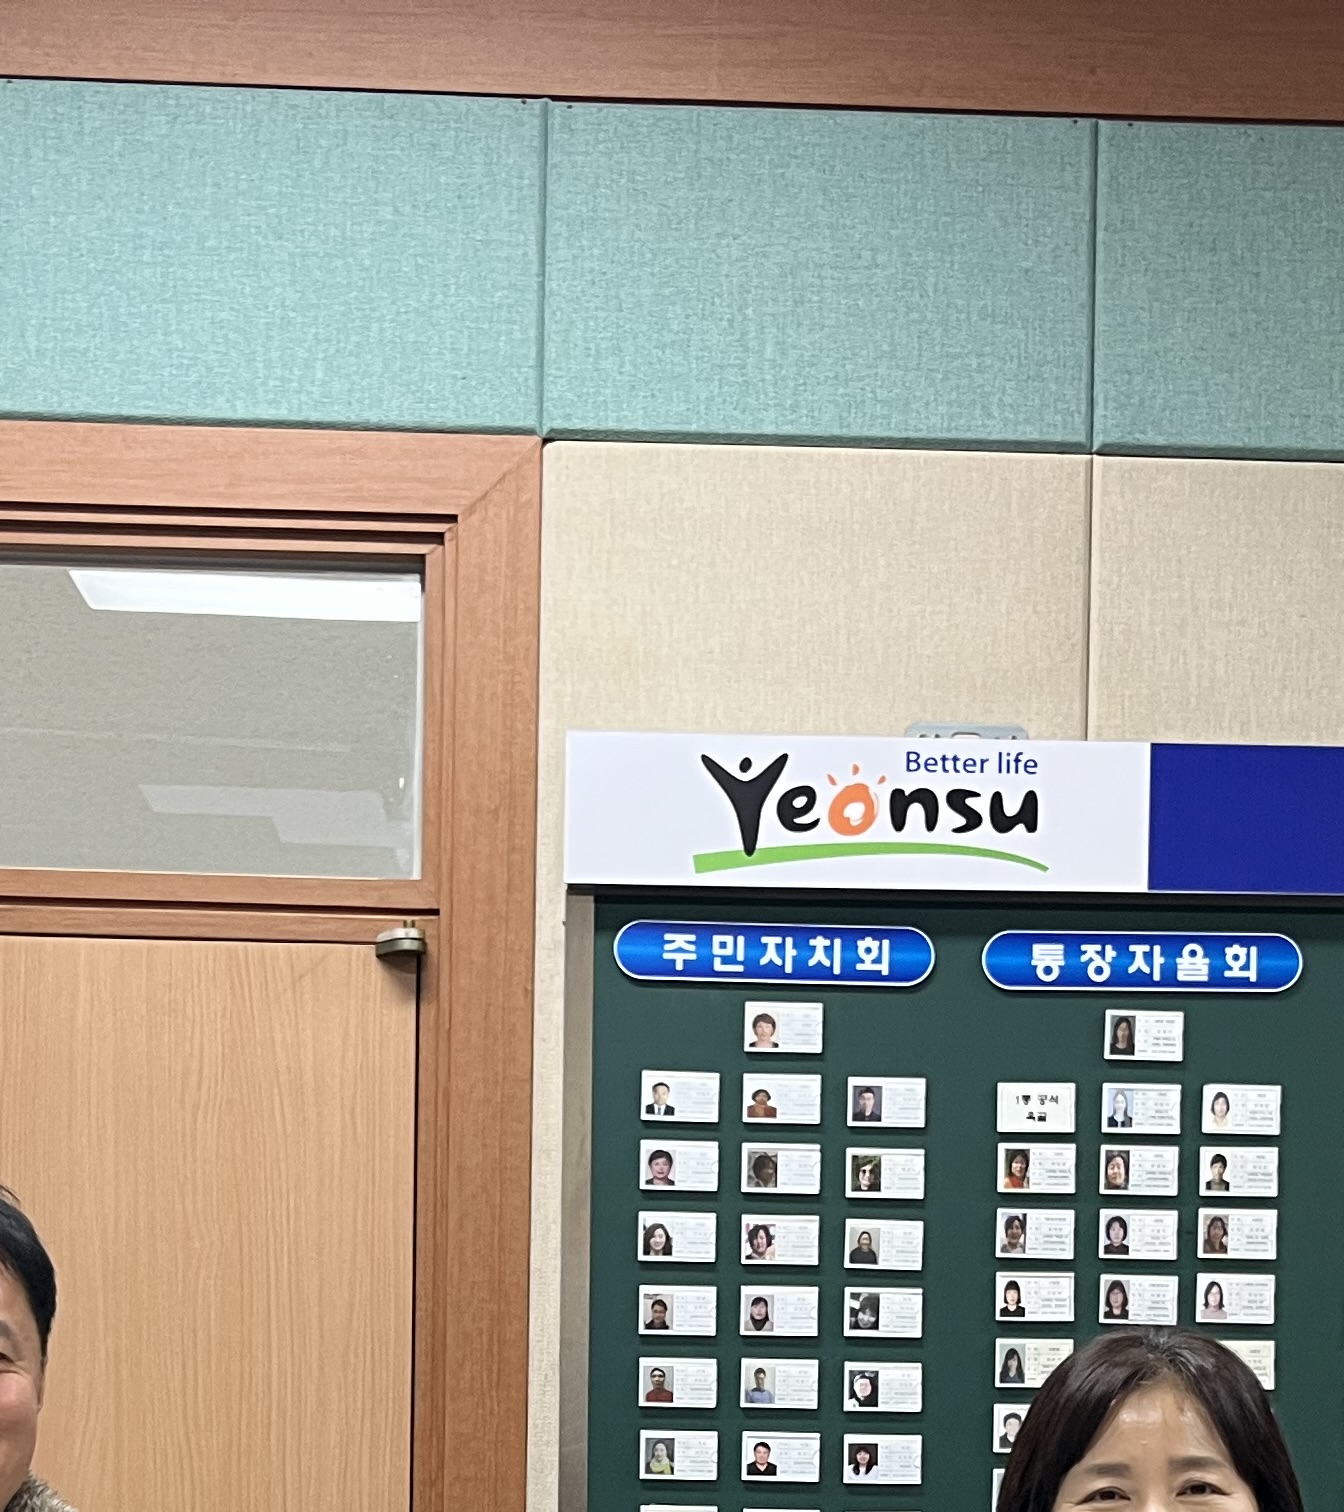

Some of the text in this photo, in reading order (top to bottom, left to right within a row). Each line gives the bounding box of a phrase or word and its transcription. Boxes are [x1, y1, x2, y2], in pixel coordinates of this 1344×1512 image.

[905, 750, 1038, 775] Better life
[700, 752, 1039, 857] Yeonsu
[661, 933, 892, 975] 주민자치회
[1030, 943, 1259, 984] 통장자율회
